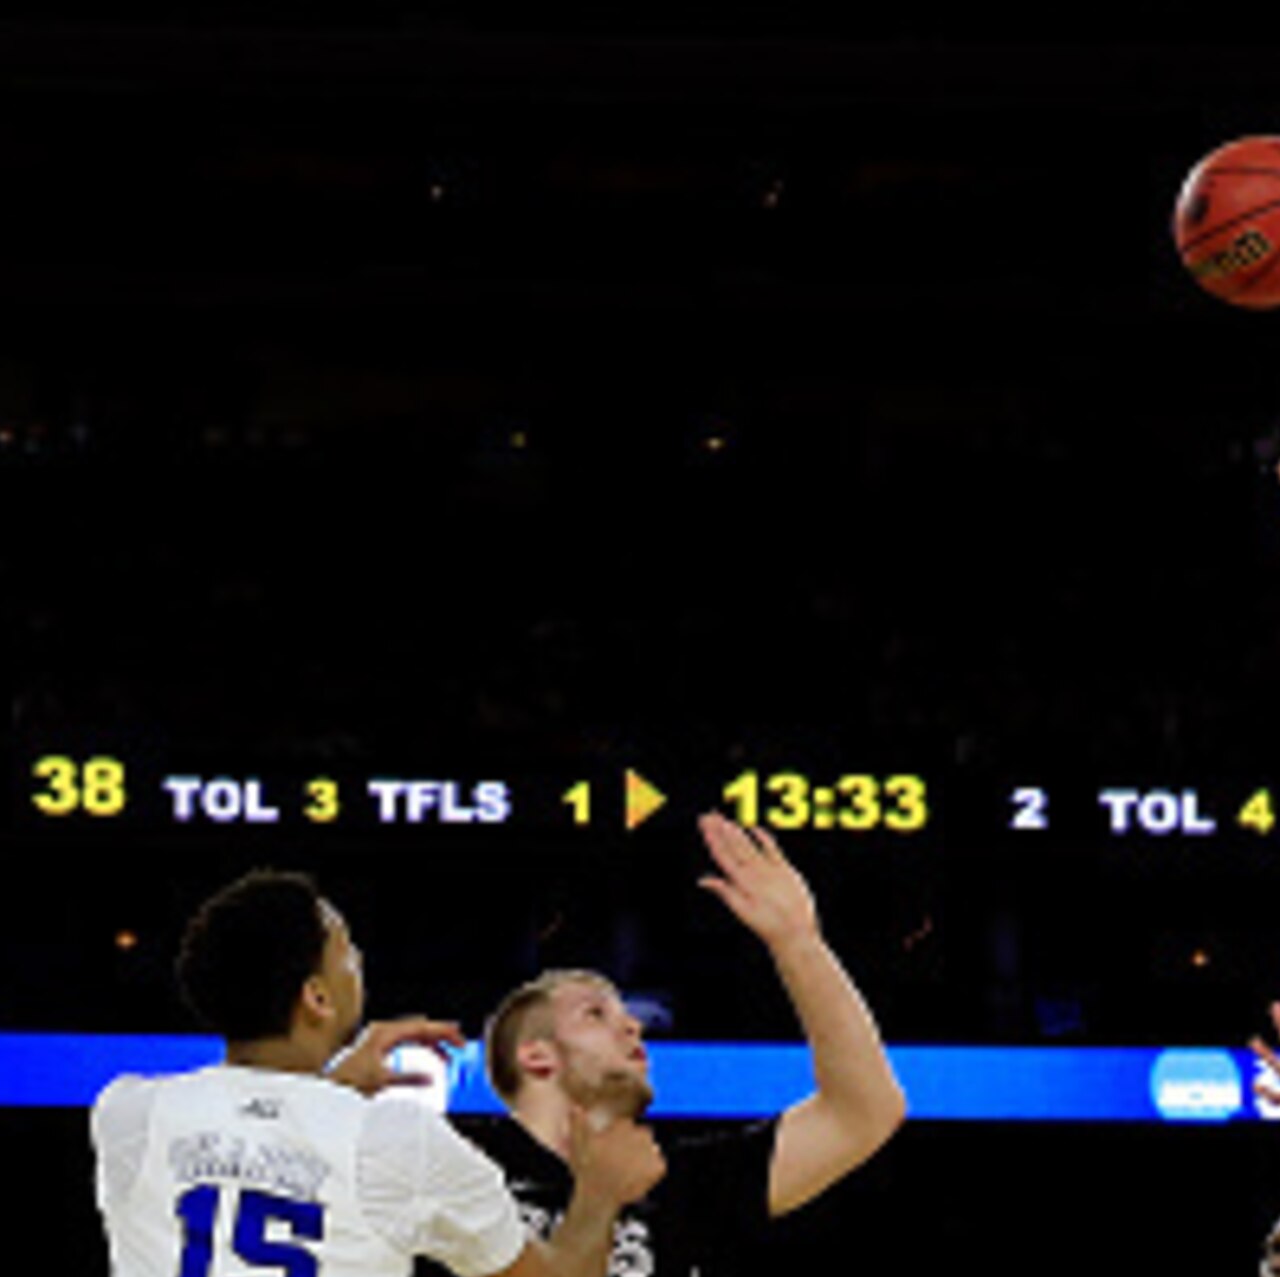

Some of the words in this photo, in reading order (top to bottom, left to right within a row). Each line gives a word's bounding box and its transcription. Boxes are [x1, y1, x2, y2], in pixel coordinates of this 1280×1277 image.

[32, 756, 126, 815] 38
[163, 776, 279, 822] TOL
[304, 778, 339, 822] 3
[368, 780, 510, 823] TFLS
[562, 781, 590, 824] 1
[722, 770, 928, 830] 13:33
[1011, 787, 1048, 829] 2
[1098, 790, 1215, 834] TOL
[1238, 789, 1275, 833] 4
